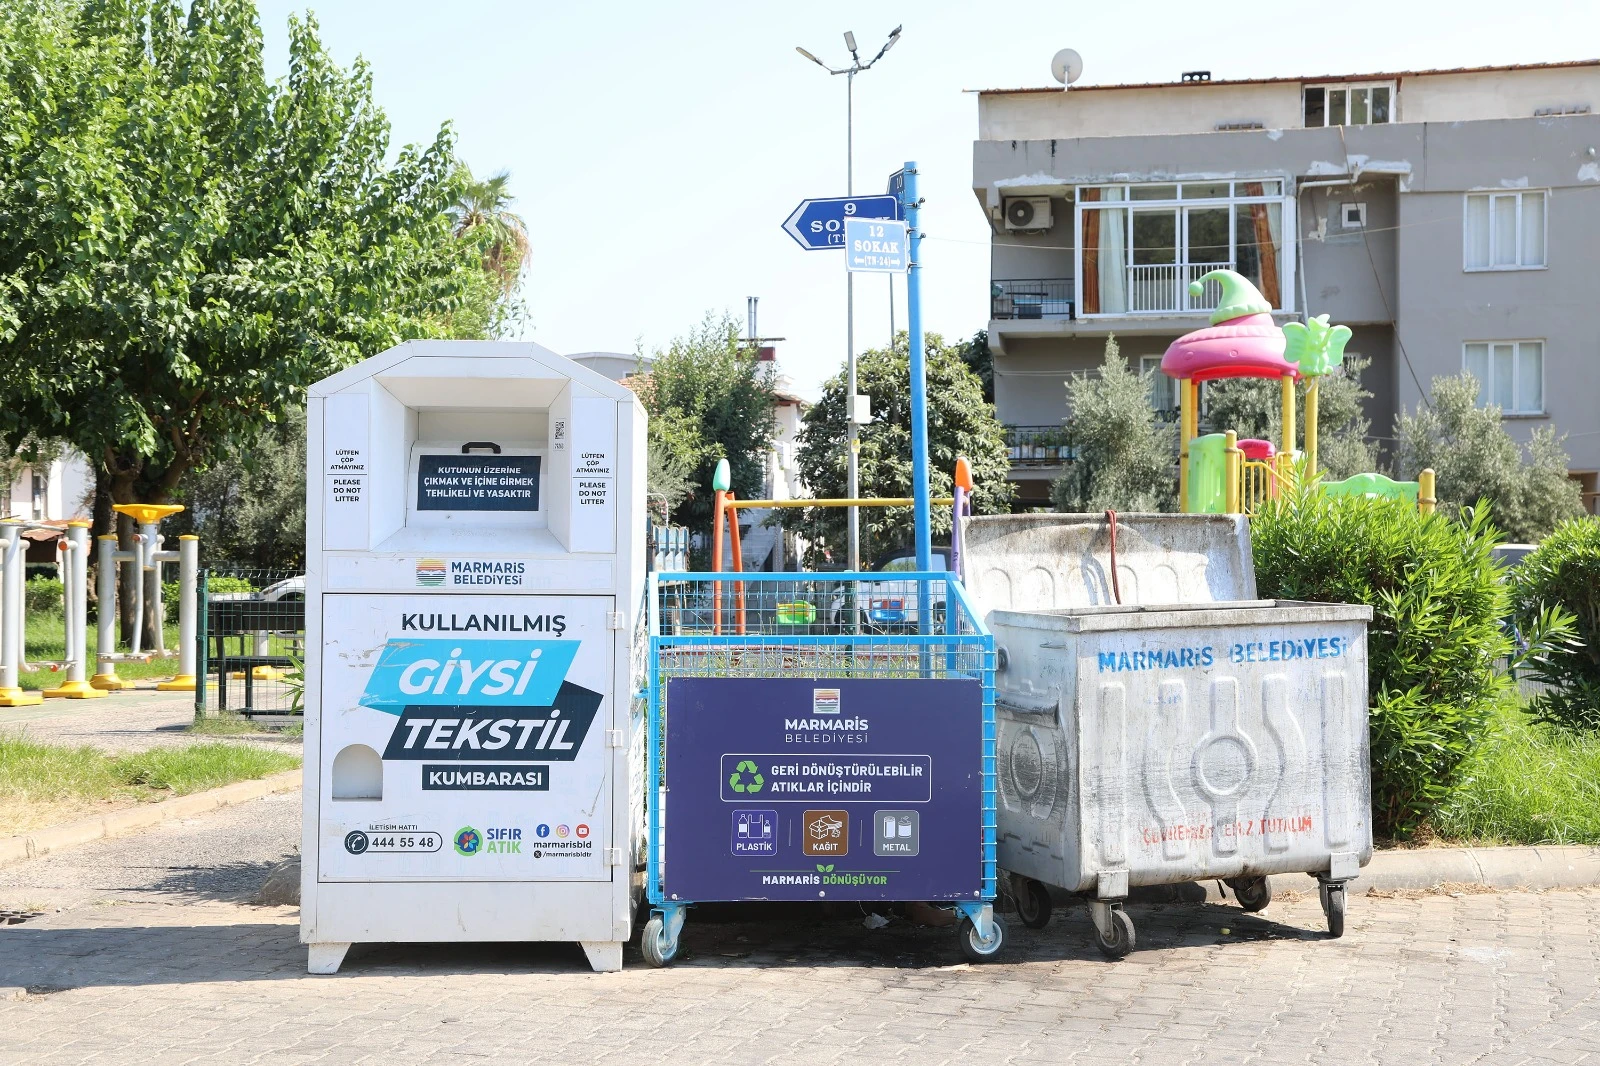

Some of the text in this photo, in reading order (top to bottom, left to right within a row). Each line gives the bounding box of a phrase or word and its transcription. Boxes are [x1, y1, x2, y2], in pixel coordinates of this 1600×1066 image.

[844, 203, 857, 215] 9
[869, 225, 884, 238] 12
[854, 239, 899, 253] SOKAK
[335, 448, 360, 456] LÜTFEN
[340, 456, 354, 464] ÇÖP
[438, 465, 522, 474] KUTUNUN ÜZERİNE
[424, 475, 534, 487] ÇIKMAK VE İÇİNE GİRMEK
[426, 488, 531, 498] TEHLİKELİ VE YASAKTIR
[401, 613, 567, 637] KULLANILMIŞ
[398, 647, 542, 695] GİYSİ
[784, 715, 869, 731] MARMARİS
[403, 709, 575, 750] TEKSTİL
[785, 732, 868, 743] BELEDİYESİ
[771, 763, 923, 778] GERİ DÖNÜŞTÜRÜLEBİLİR
[429, 772, 543, 786] KUMBARASI
[771, 780, 872, 794] ATIKLAR İÇİNDİR
[486, 828, 522, 840] SIFIR
[372, 837, 434, 848] 444 55 48
[486, 841, 522, 854] ATIK
[533, 841, 592, 849] marmarisbld
[736, 842, 773, 851] PLASTİK
[812, 842, 839, 851] KAĞIT
[882, 843, 911, 851] METAL
[762, 874, 887, 887] MARMARİS DÖNÜŞÜYOR
